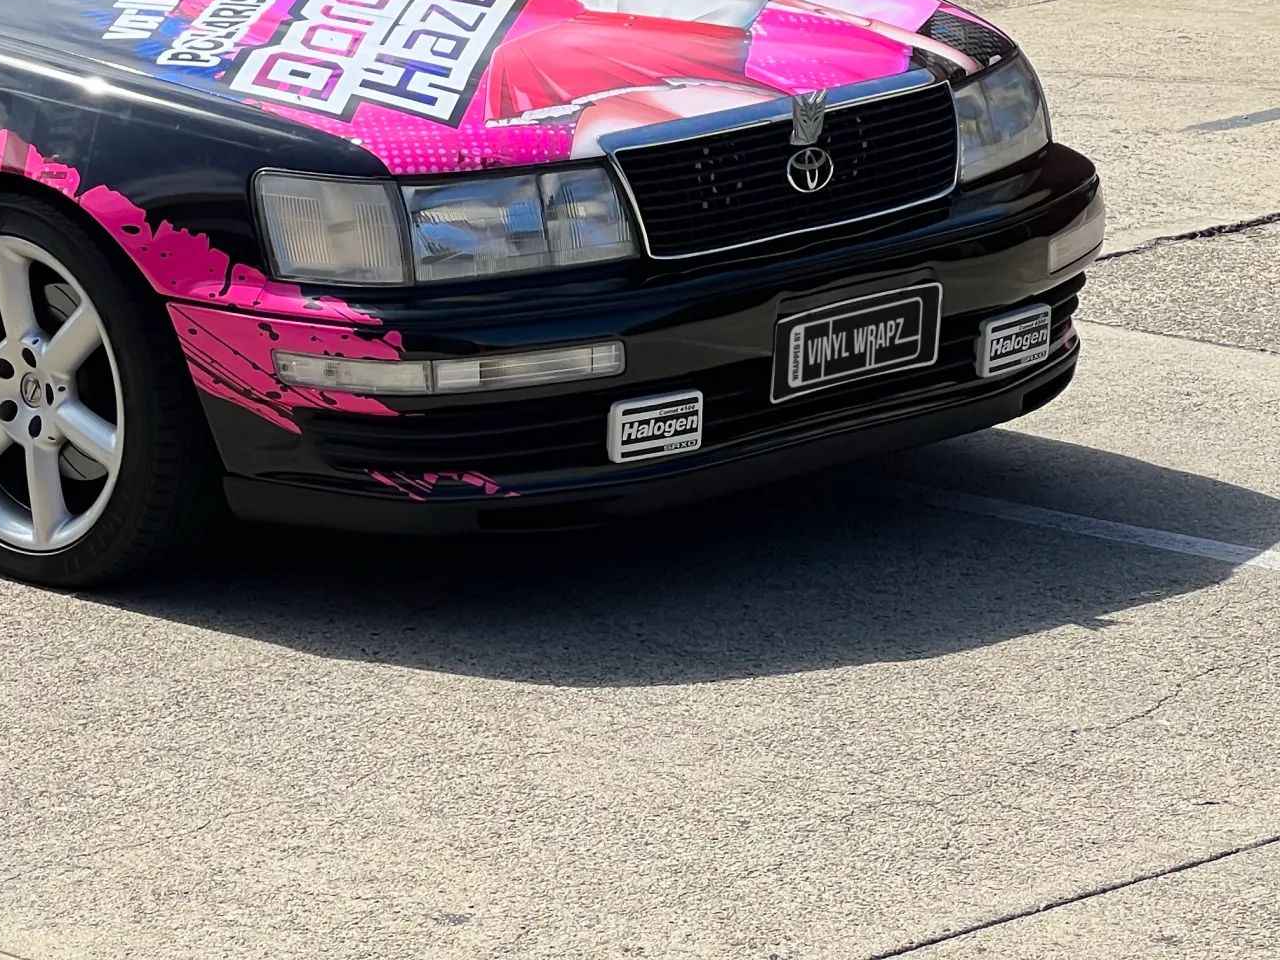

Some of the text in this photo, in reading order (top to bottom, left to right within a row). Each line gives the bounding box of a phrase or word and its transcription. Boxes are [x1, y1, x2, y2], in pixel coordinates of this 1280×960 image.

[808, 317, 907, 367] VINYL WRAPZ
[990, 328, 1048, 357] Halogen
[792, 332, 801, 382] WRAPPED BY
[658, 404, 696, 416] Comet 4500
[622, 415, 699, 441] Halogen
[663, 440, 697, 451] SAXO
